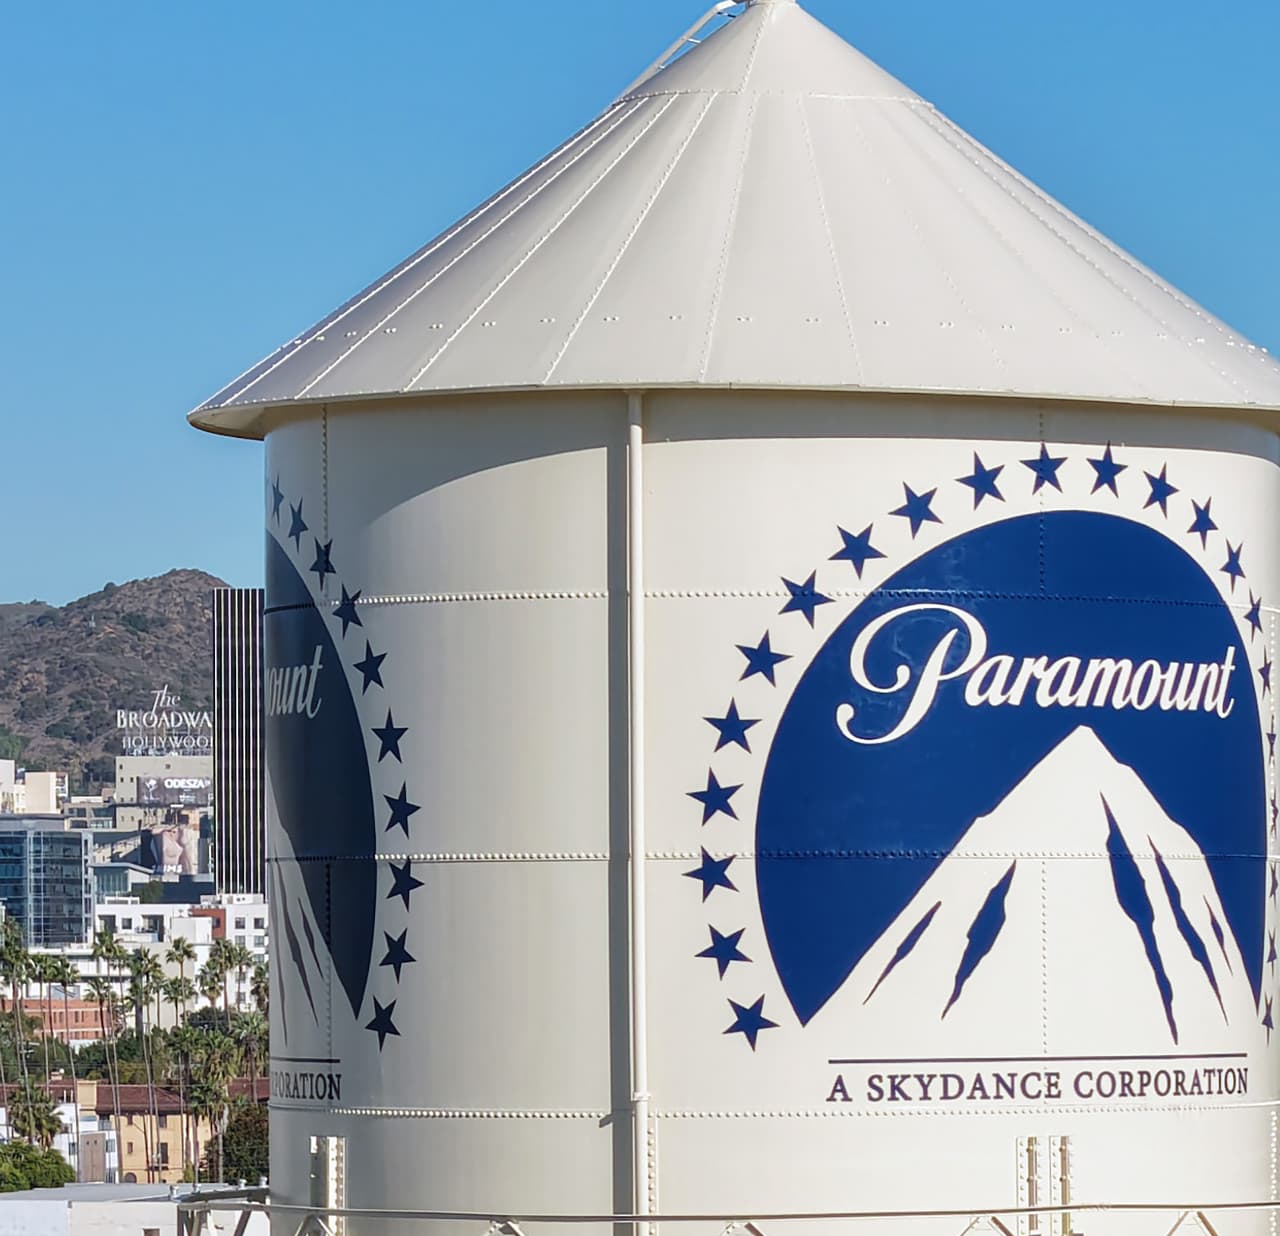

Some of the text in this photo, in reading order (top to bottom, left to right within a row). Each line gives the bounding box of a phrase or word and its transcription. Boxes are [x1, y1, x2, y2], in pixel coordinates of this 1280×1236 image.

[836, 603, 1236, 744] Paramount
[117, 709, 213, 729] BROADWA
[150, 684, 181, 720] The
[122, 736, 213, 749] HOLLYWOO
[826, 1068, 1248, 1103] A SKYDANCE CORPORATION
